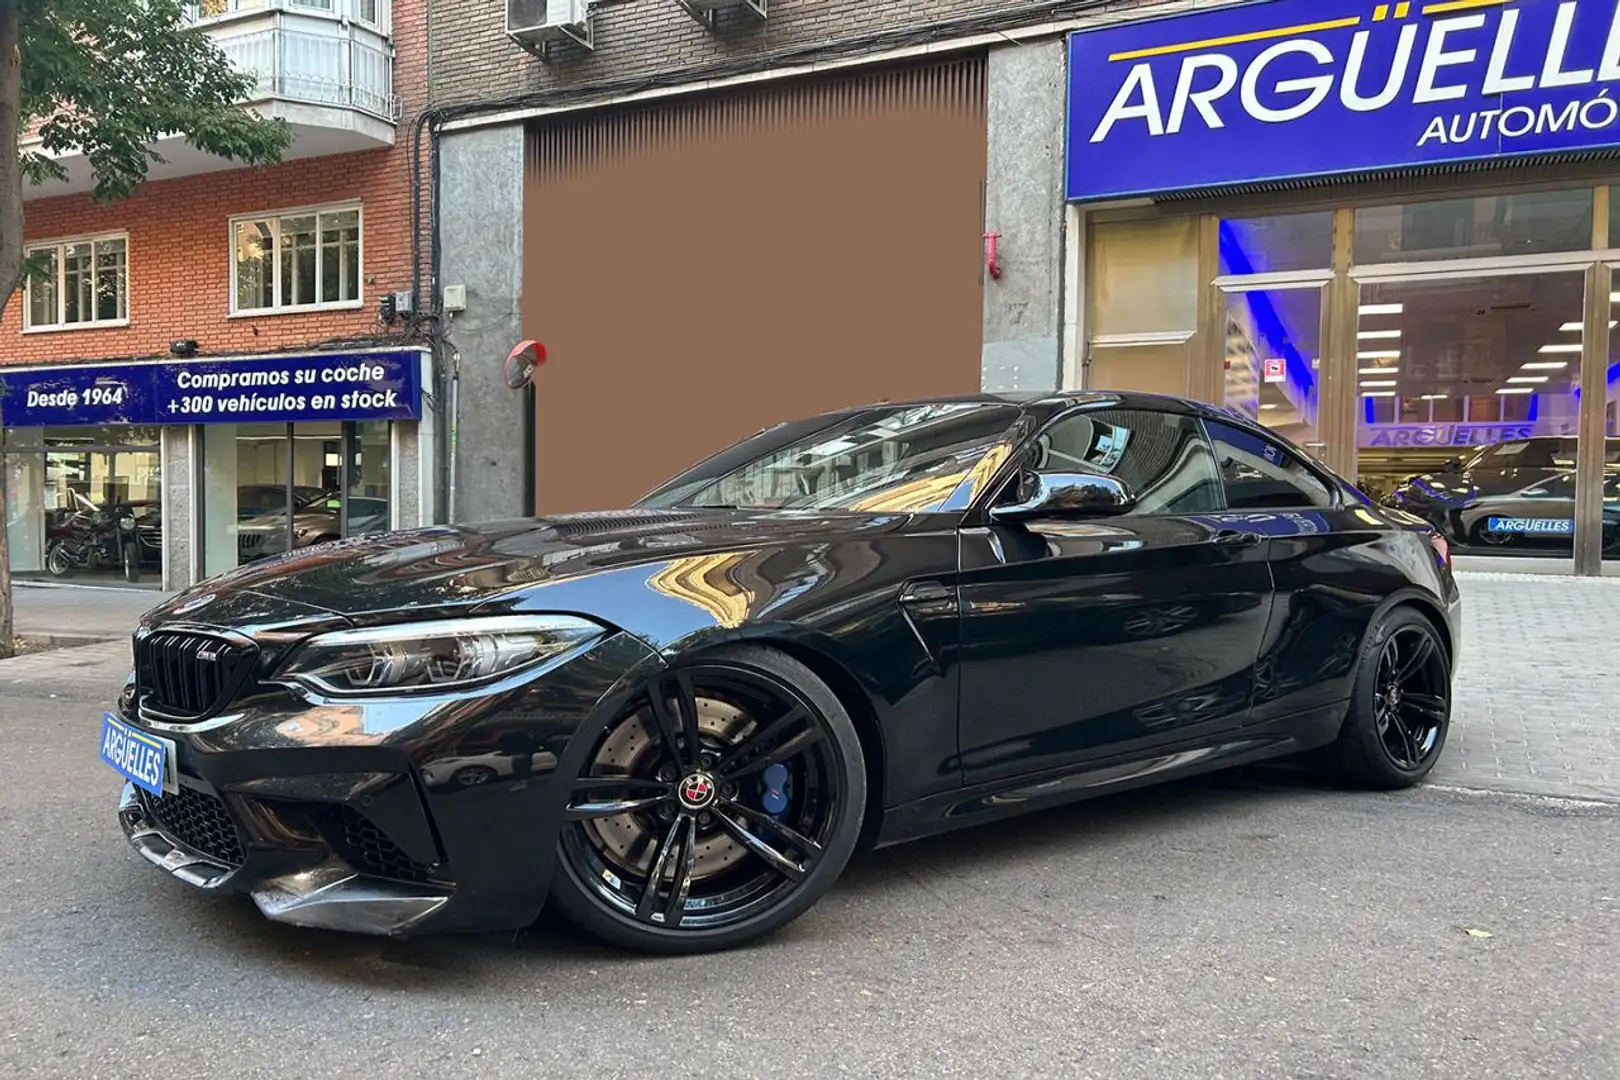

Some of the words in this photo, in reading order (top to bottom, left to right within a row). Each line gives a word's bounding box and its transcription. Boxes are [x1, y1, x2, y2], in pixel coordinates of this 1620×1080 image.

[1416, 88, 1618, 147] AUTOMÓ
[177, 371, 290, 391] Compramos
[294, 369, 317, 385] su
[321, 362, 385, 384] coche
[26, 389, 79, 409] Desde
[82, 387, 124, 406] 1964
[167, 395, 214, 415] +300
[217, 393, 306, 412] vehículos
[310, 395, 336, 410] en
[340, 388, 398, 409] stock
[102, 727, 161, 787] ARGÜELLES
